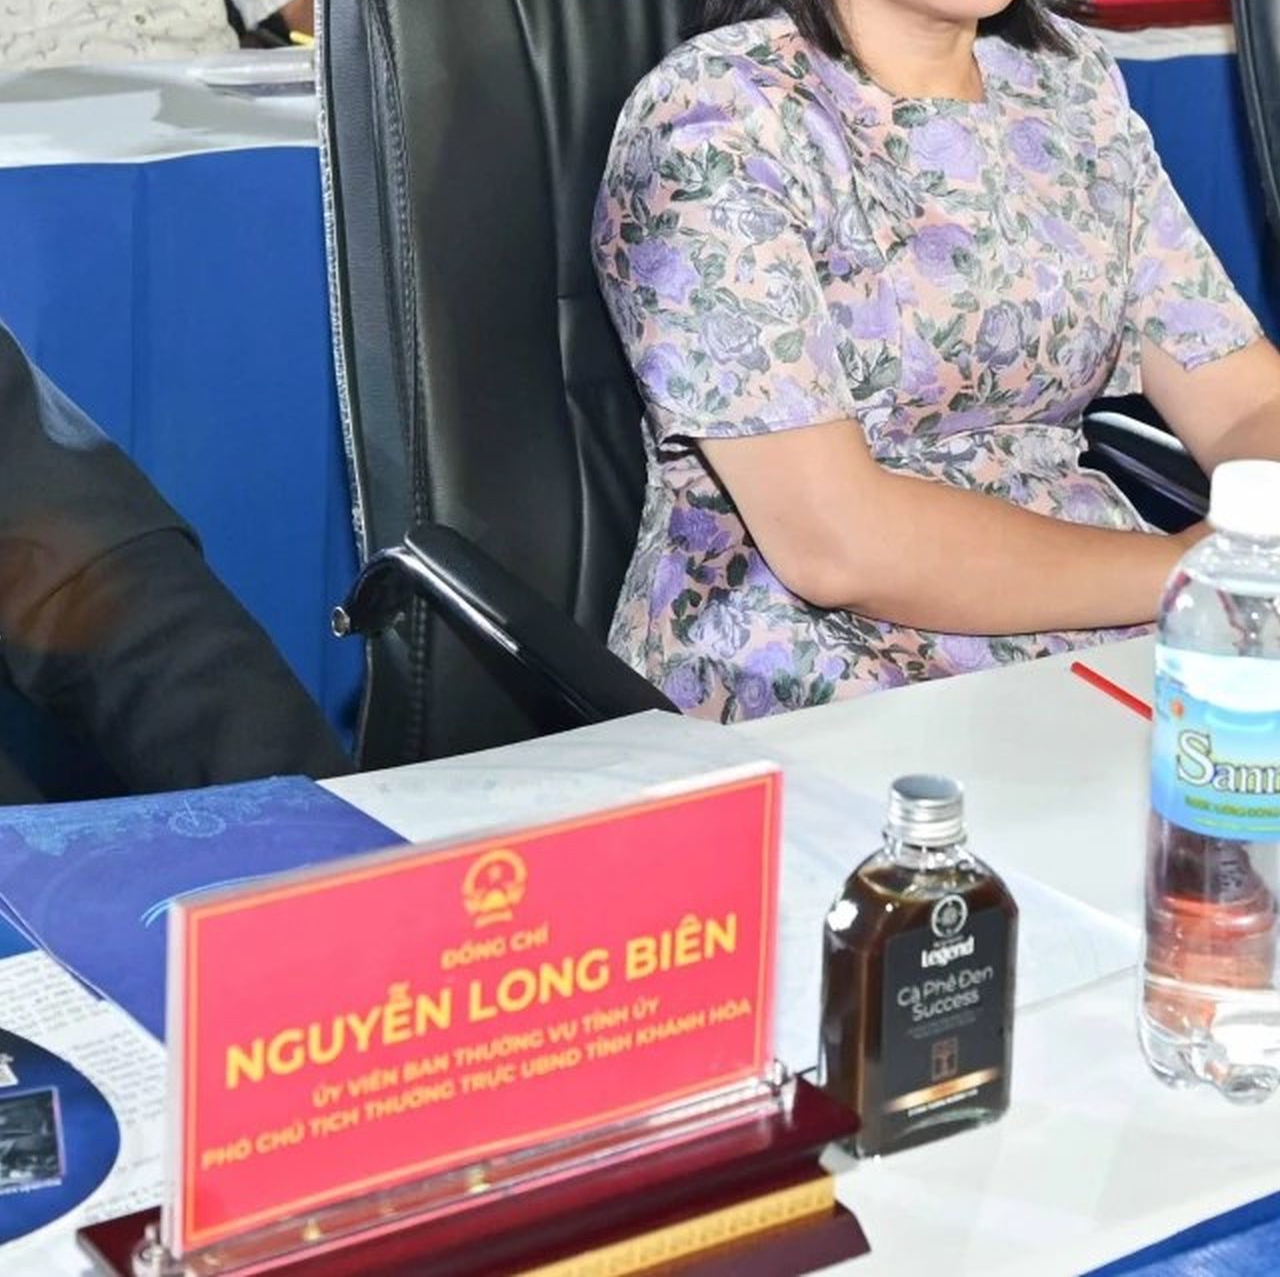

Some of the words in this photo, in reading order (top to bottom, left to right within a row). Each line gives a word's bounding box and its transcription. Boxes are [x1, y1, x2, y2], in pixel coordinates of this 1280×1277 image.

[921, 935, 975, 968] Legend
[225, 980, 452, 1090] NGUYỄN
[468, 948, 610, 1022] LONG
[625, 913, 737, 981] BIÊN
[923, 974, 956, 998] Phê
[912, 989, 980, 1022] Success
[520, 1047, 582, 1079] UBND
[708, 996, 752, 1025] HÒA
[347, 1066, 398, 1097] VIÊN
[403, 1054, 449, 1081] BAN
